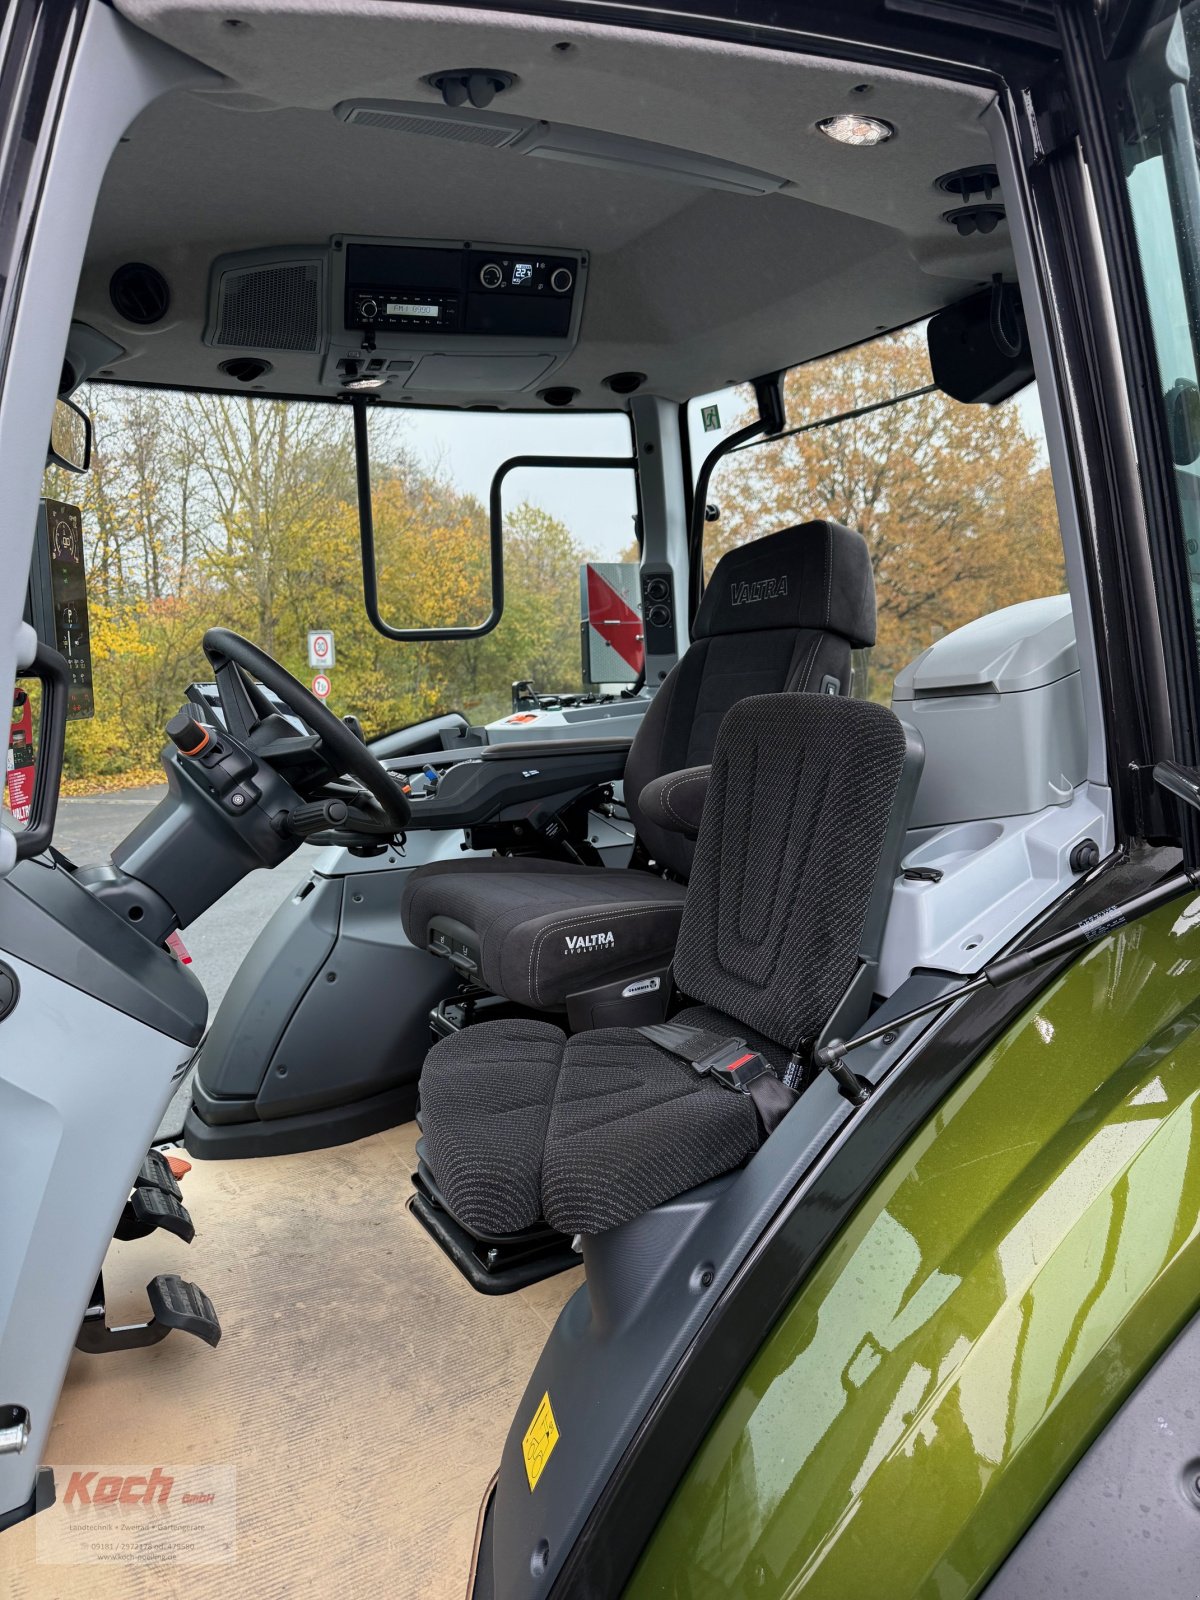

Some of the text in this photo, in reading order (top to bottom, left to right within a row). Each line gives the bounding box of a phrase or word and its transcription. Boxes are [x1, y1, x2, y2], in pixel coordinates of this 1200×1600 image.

[731, 575, 787, 605] VALTRA
[564, 942, 615, 955] EVOLUTION
[565, 931, 614, 949] VALTRA
